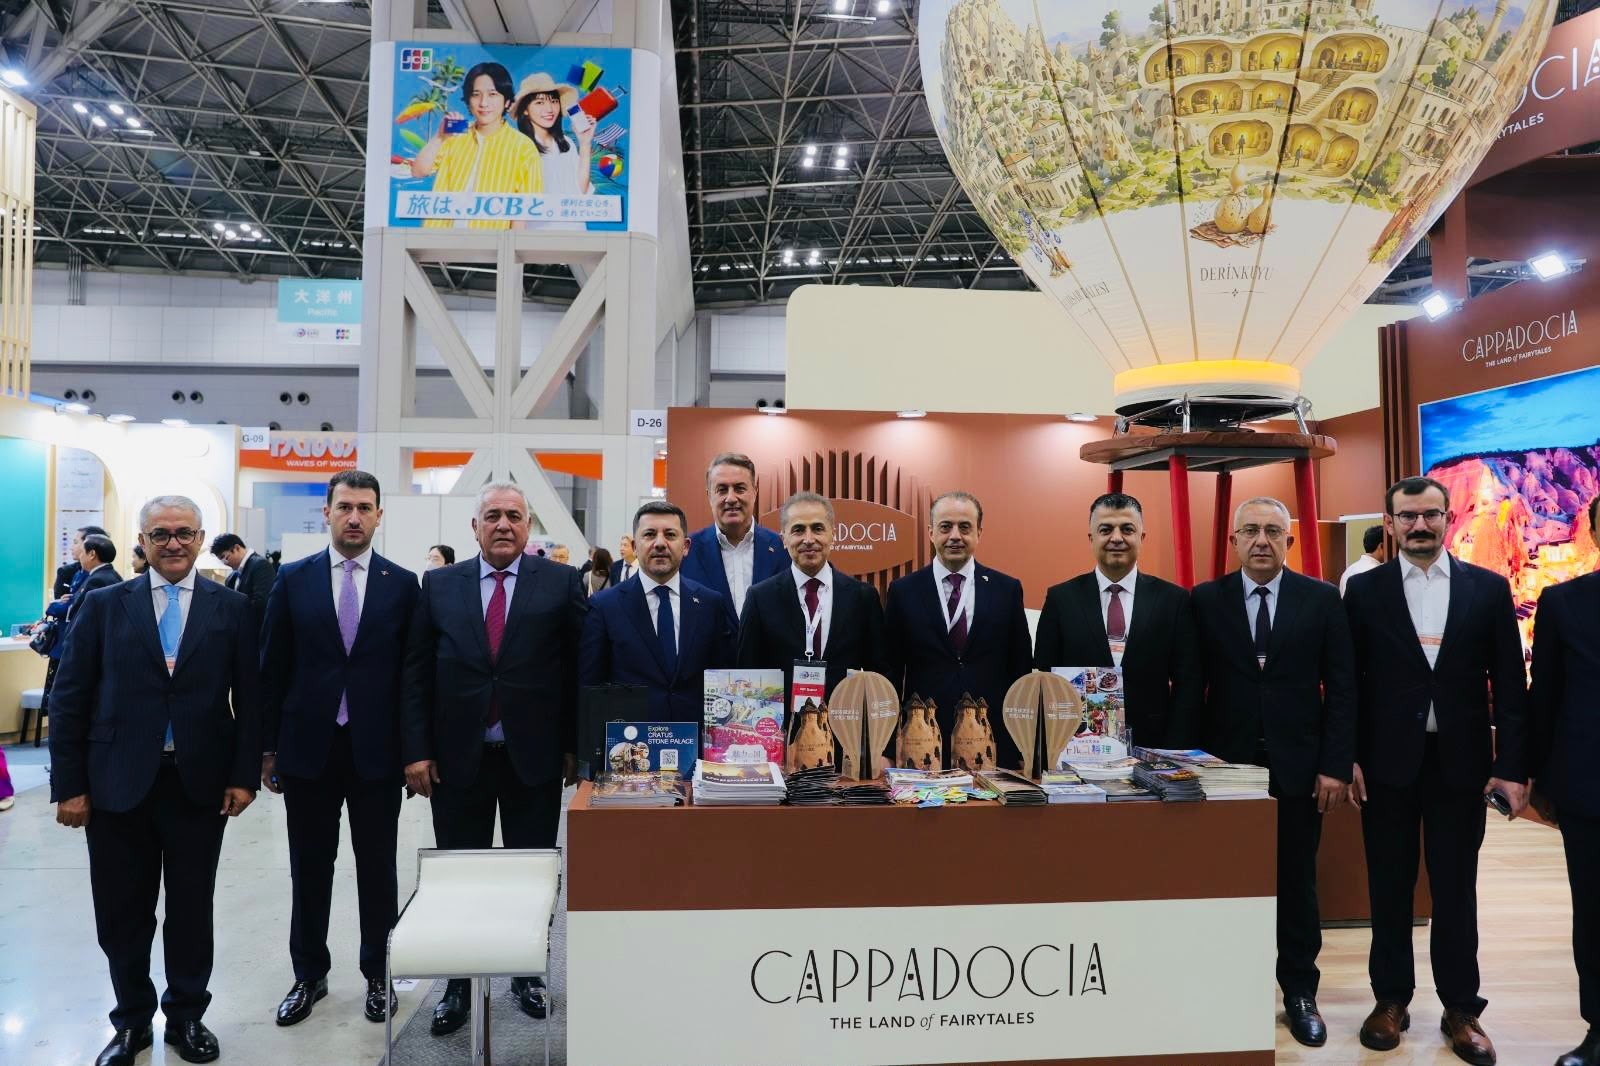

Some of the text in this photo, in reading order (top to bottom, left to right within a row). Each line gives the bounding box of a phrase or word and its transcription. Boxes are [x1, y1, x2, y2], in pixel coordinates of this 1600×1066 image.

[294, 288, 352, 304] 大洋州
[1462, 310, 1577, 362] CAPPADOCIA
[1497, 357, 1512, 365] LAND
[1513, 354, 1519, 362] of
[1519, 346, 1552, 360] FAIRYTALES
[637, 417, 662, 428] D-26
[242, 434, 264, 443] G-09
[330, 460, 357, 468] WOND
[1066, 744, 1112, 755] トルコ料理
[750, 942, 1107, 1003] CAPPADOCIA
[830, 1012, 1035, 1030] THE LAND of FAIRYTALES
